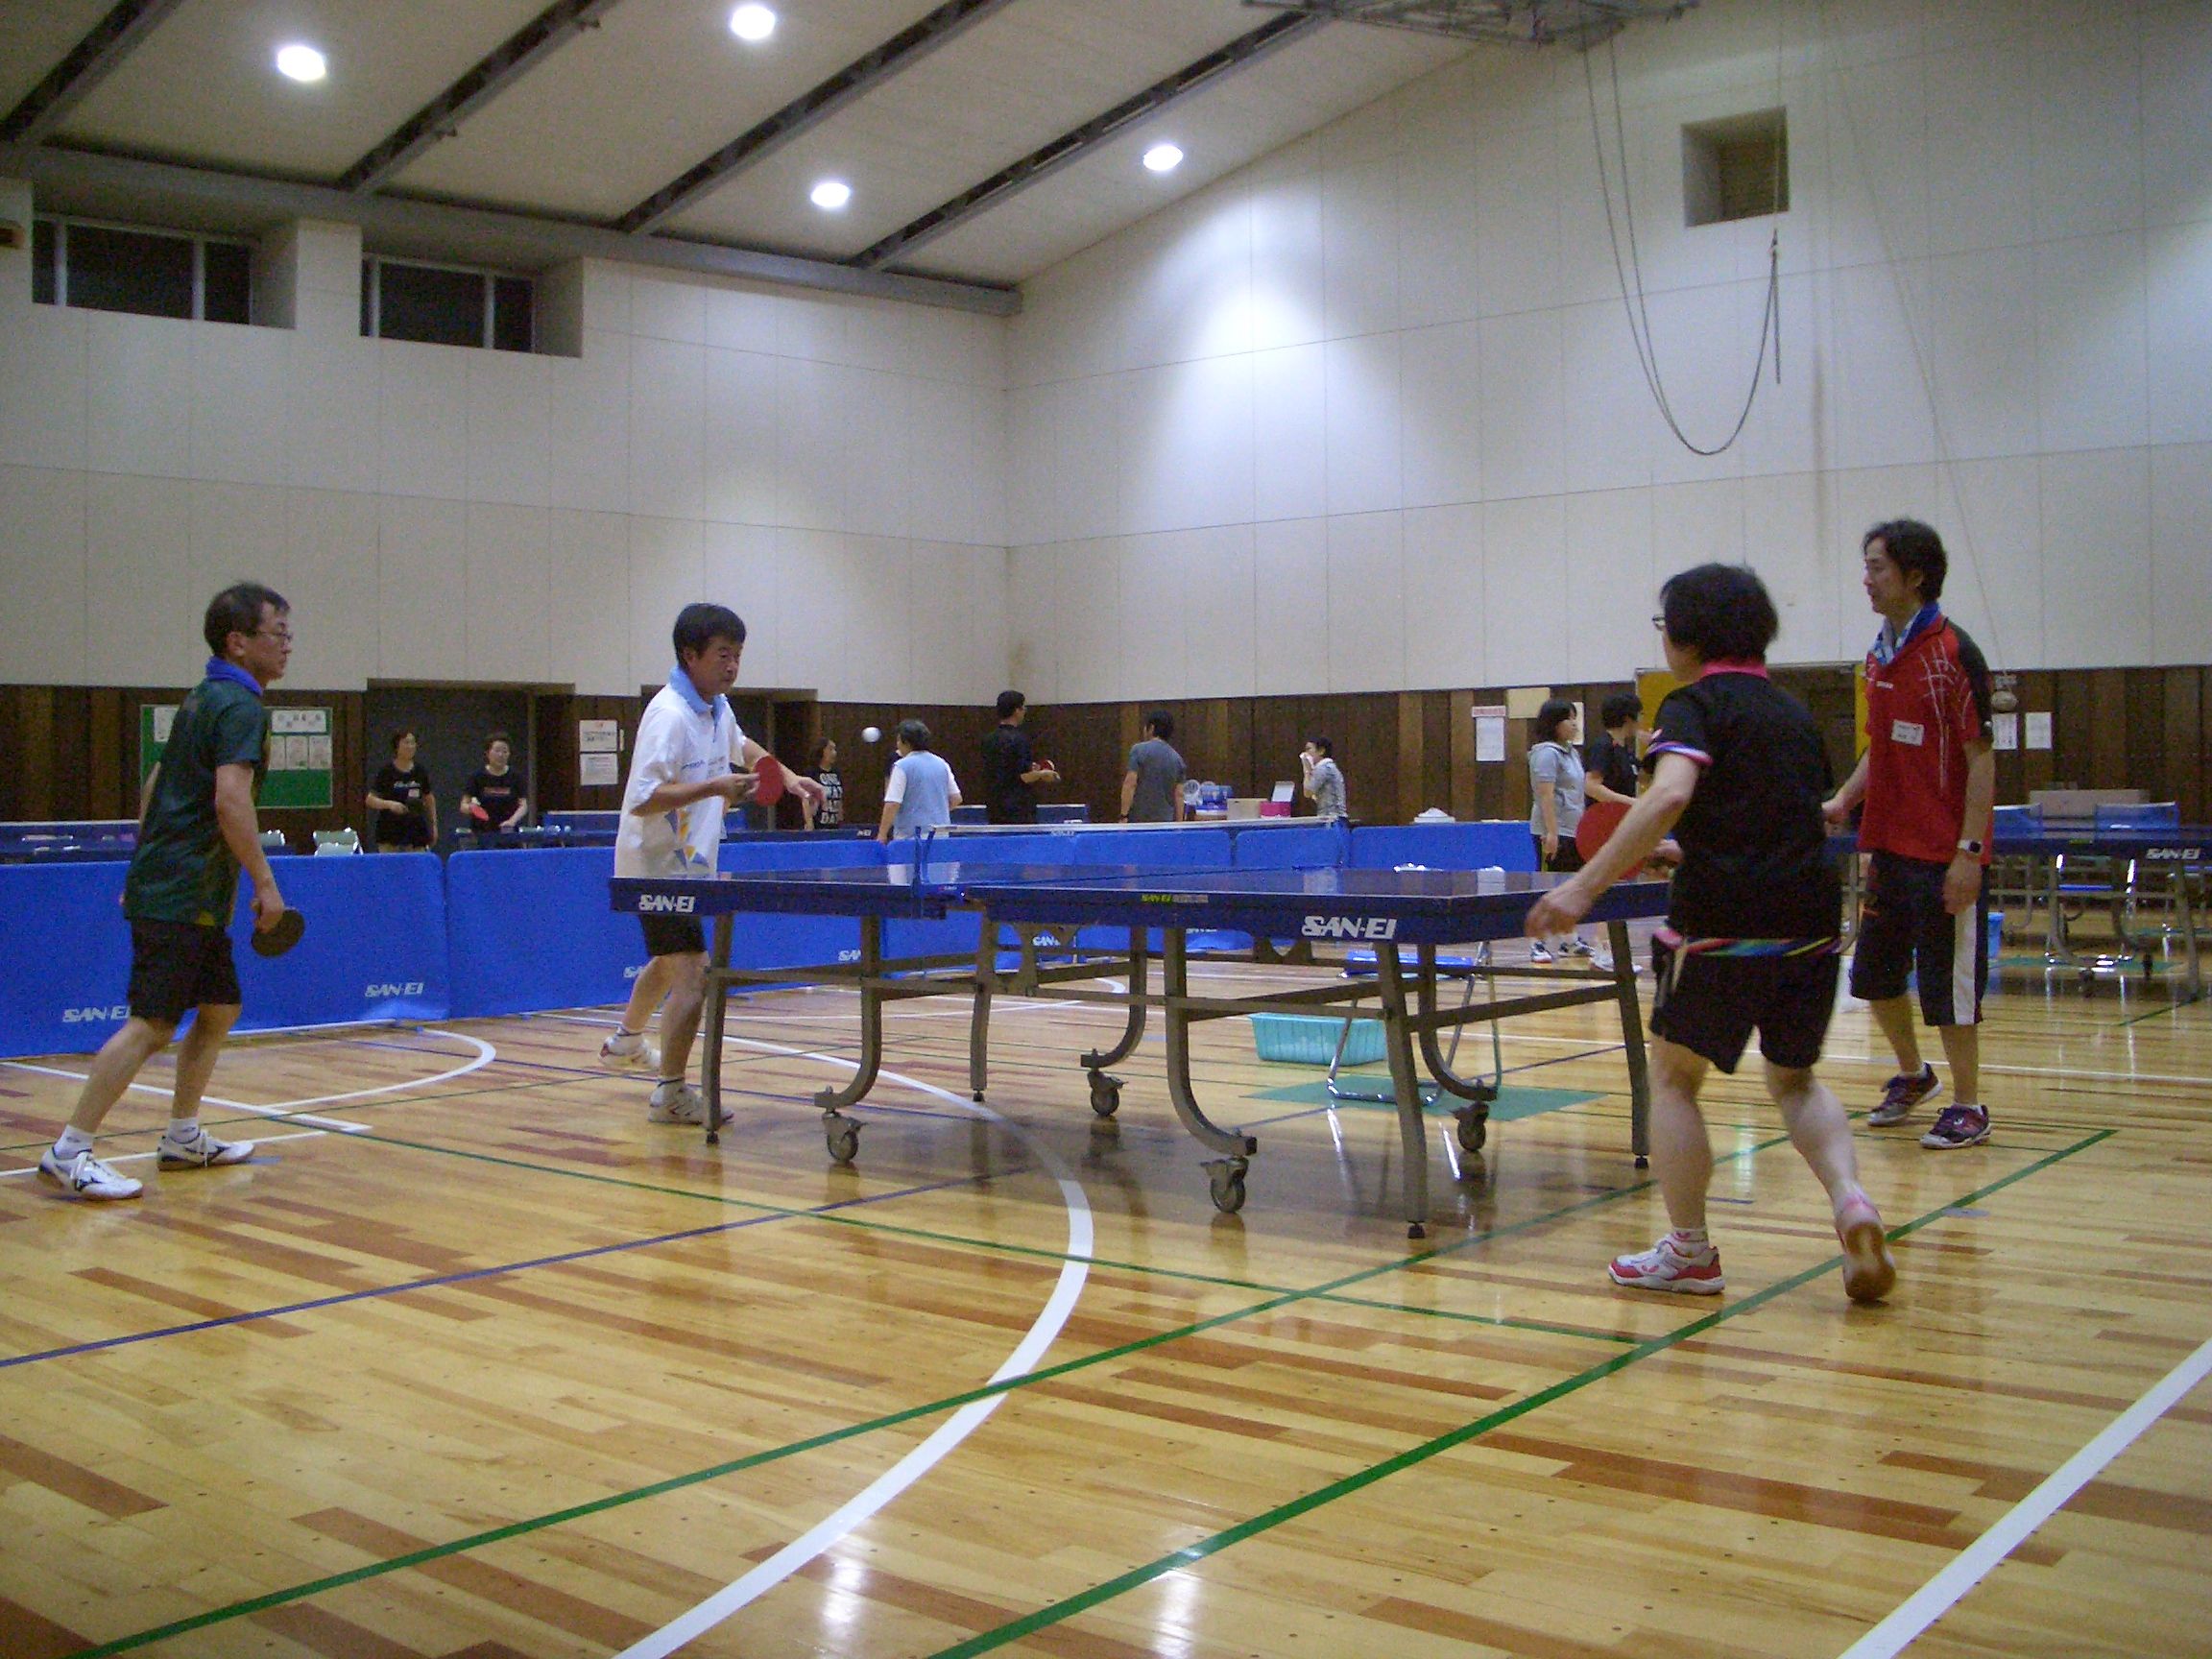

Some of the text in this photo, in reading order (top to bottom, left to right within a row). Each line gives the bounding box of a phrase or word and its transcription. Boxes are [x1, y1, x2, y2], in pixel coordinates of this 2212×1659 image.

[2147, 848, 2200, 859] SAN-EI
[638, 895, 695, 913] SAN-EI
[1302, 915, 1397, 940] SAN-EI
[365, 982, 424, 998] SAN-EI
